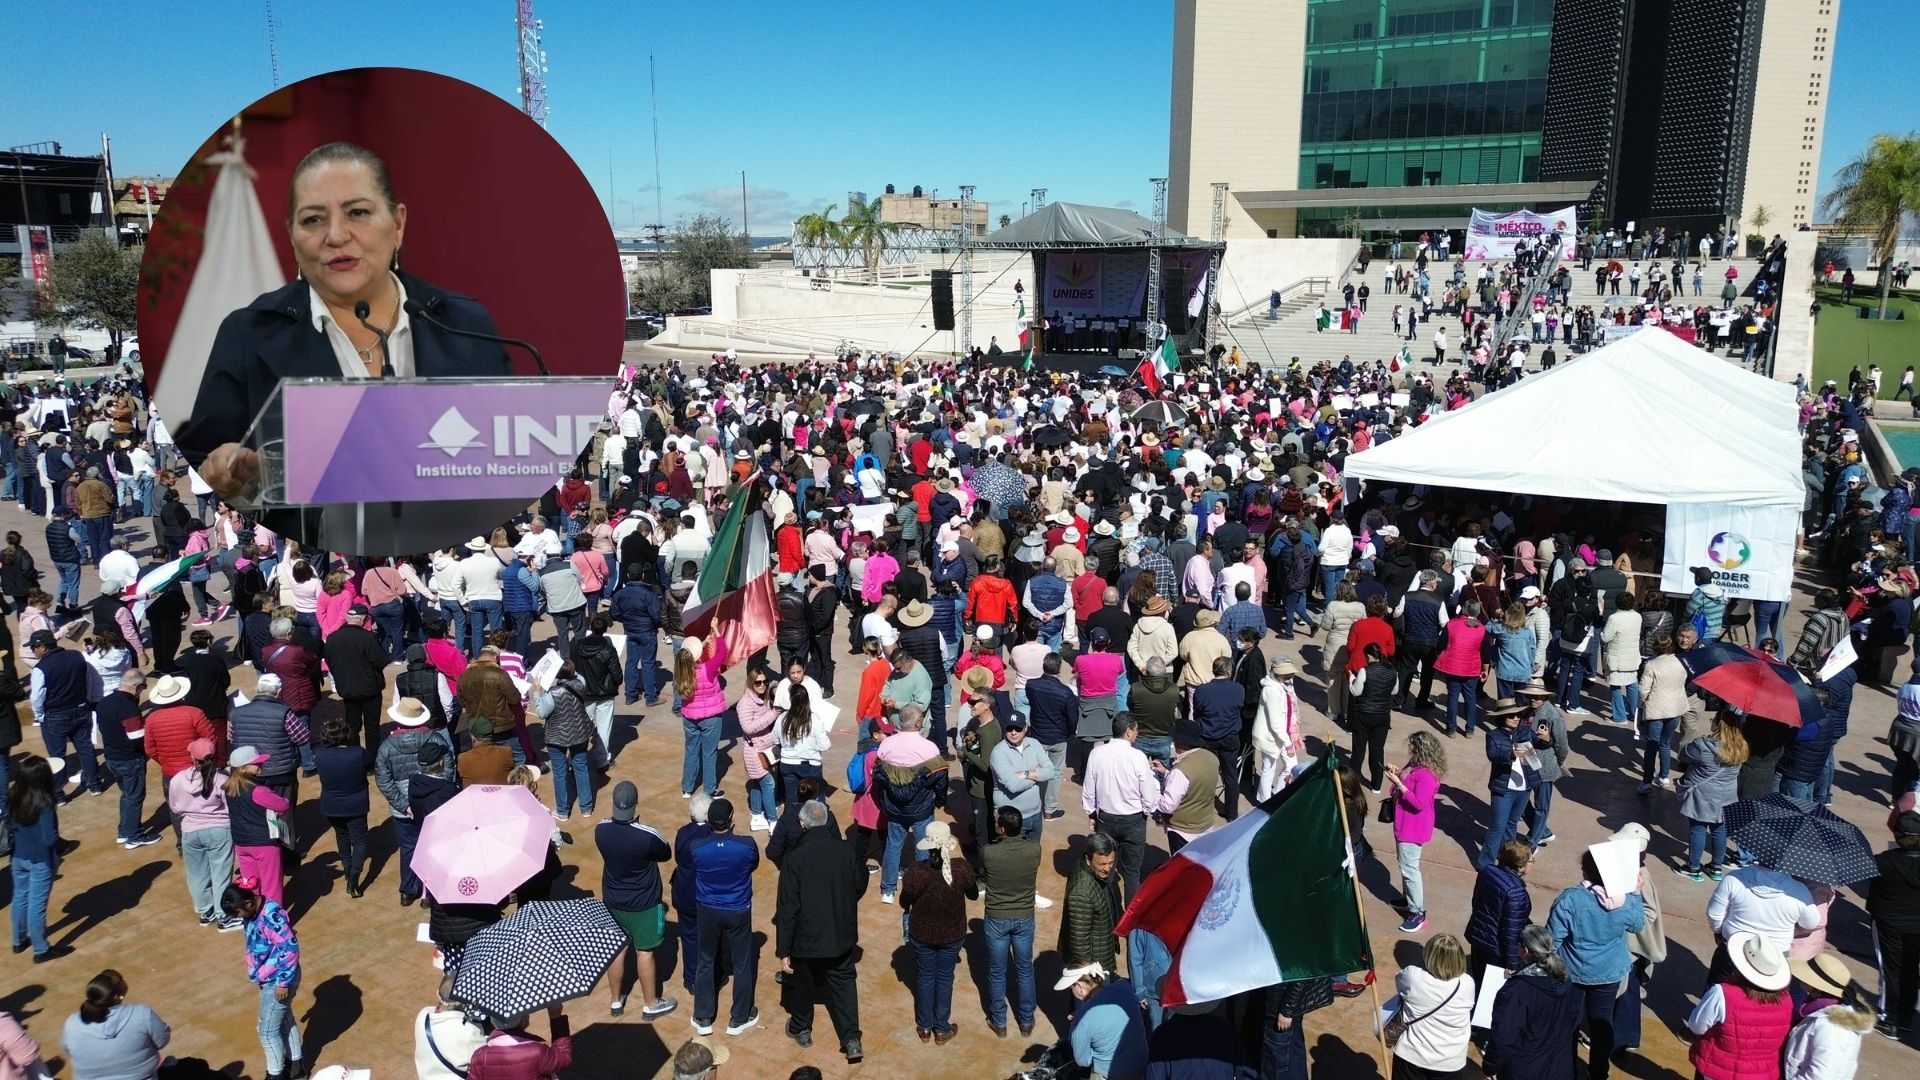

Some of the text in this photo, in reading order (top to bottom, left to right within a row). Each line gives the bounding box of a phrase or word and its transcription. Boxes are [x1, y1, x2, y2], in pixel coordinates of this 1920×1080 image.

[1052, 288, 1094, 299] UNID@S
[416, 465, 482, 477] Instituto
[487, 463, 553, 475] Nacional
[1711, 571, 1749, 583] ODER
